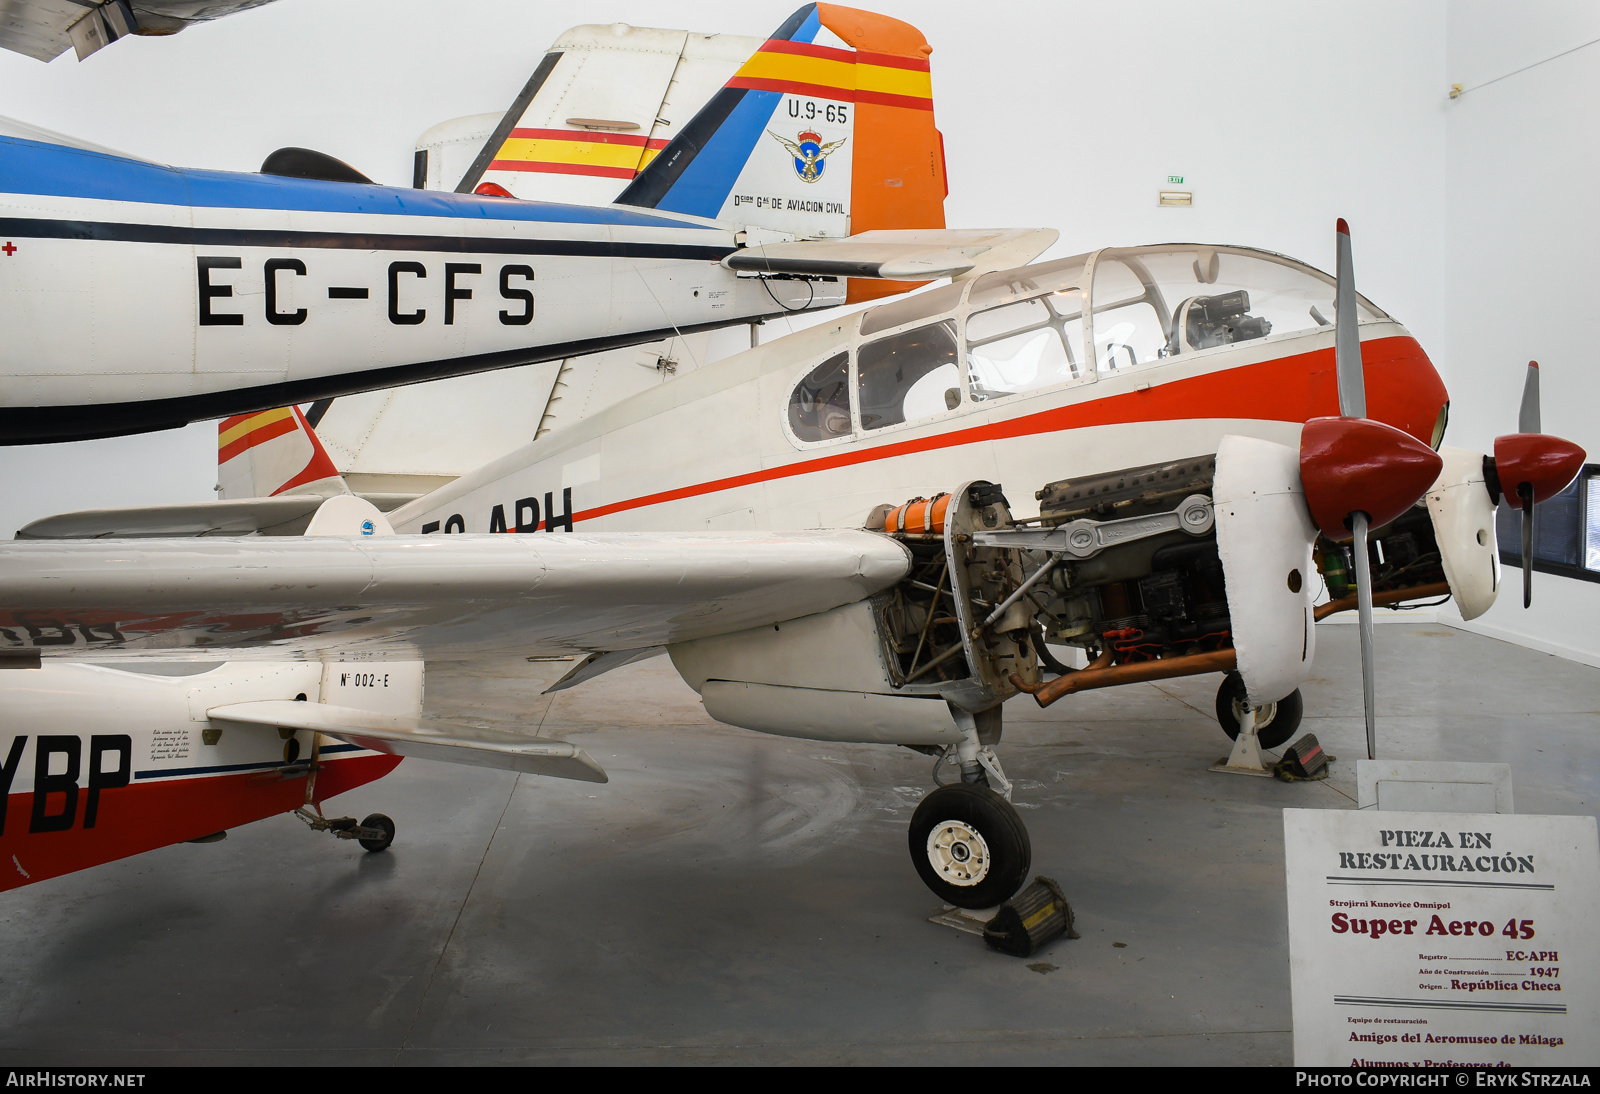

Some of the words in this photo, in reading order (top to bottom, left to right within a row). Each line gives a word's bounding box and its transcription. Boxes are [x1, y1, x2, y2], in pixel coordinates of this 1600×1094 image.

[788, 99, 847, 124] U.9-65
[1169, 176, 1183, 184] EXIT
[771, 197, 782, 210] DE
[786, 199, 824, 213] AVIACION
[826, 202, 845, 214] CIVIL
[196, 256, 535, 326] EC-CFS
[1379, 830, 1454, 848] PIEZA
[1458, 832, 1492, 849] EN
[1339, 851, 1535, 873] RESTAURACIÓN
[1329, 899, 1369, 909] Strojirni
[1370, 900, 1412, 909] Kunovice
[1413, 901, 1451, 910] Omnipol
[1331, 912, 1418, 940] Super
[1425, 914, 1495, 937] Aero
[1502, 917, 1536, 940] 45
[1418, 953, 1448, 961] Registro
[1506, 950, 1559, 962] EC-APH
[1434, 968, 1443, 976] de
[1443, 968, 1490, 976] Construcción
[1529, 966, 1560, 978] 1947
[1418, 983, 1443, 991] Origen
[1450, 978, 1519, 993] República
[1521, 980, 1562, 992] Checa
[1347, 1016, 1373, 1025] Equipo
[1348, 1031, 1398, 1045] Amigos
[1400, 1032, 1422, 1043] del
[1424, 1032, 1498, 1045] Aeromuseo
[1500, 1034, 1516, 1045] de
[1518, 1034, 1565, 1048] Málaga
[1350, 1057, 1410, 1068] Alumnos
